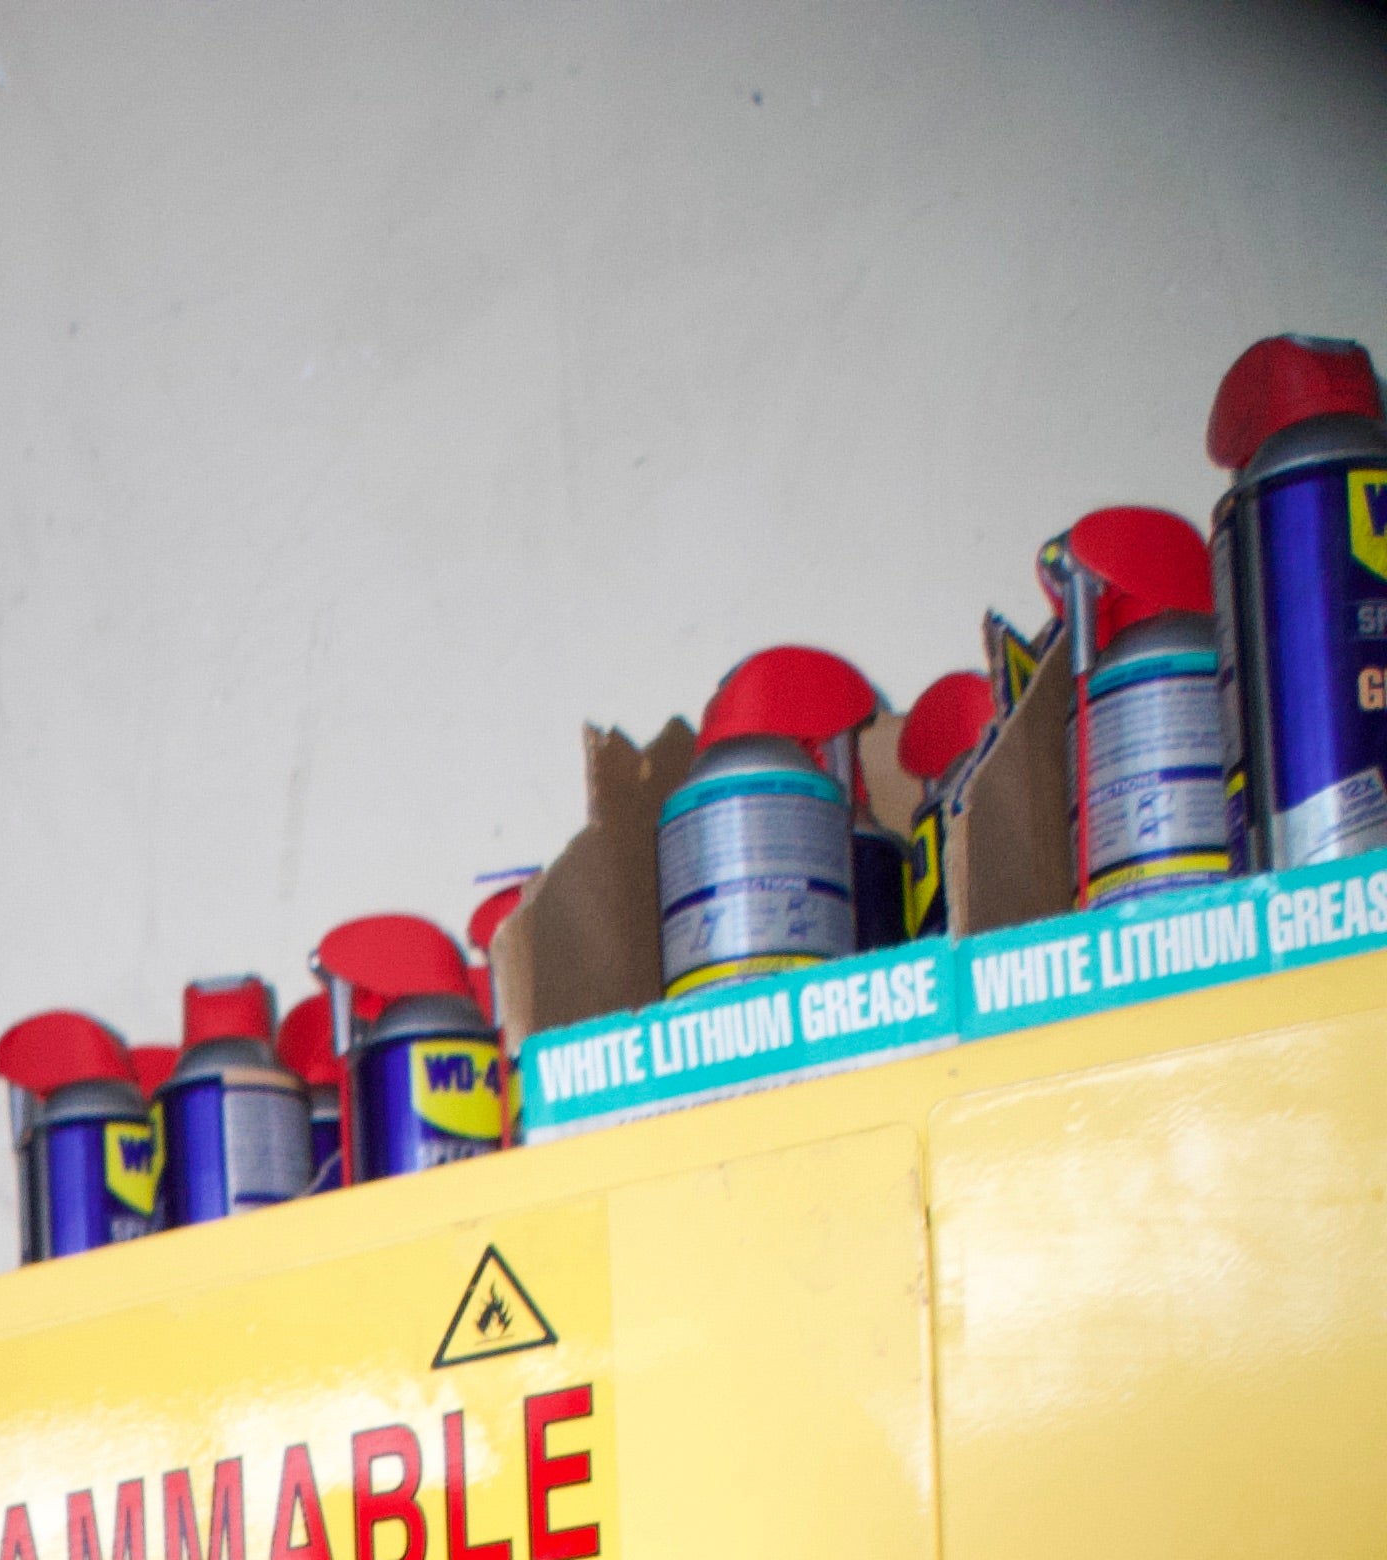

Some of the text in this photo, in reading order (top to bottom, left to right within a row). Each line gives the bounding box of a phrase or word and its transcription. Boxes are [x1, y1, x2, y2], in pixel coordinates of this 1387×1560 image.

[970, 934, 1092, 1014] WHITE
[1098, 900, 1259, 989] LITHIUM
[424, 1052, 520, 1097] WD-4
[537, 959, 939, 1104] WHITE LITHIUM GREASE
